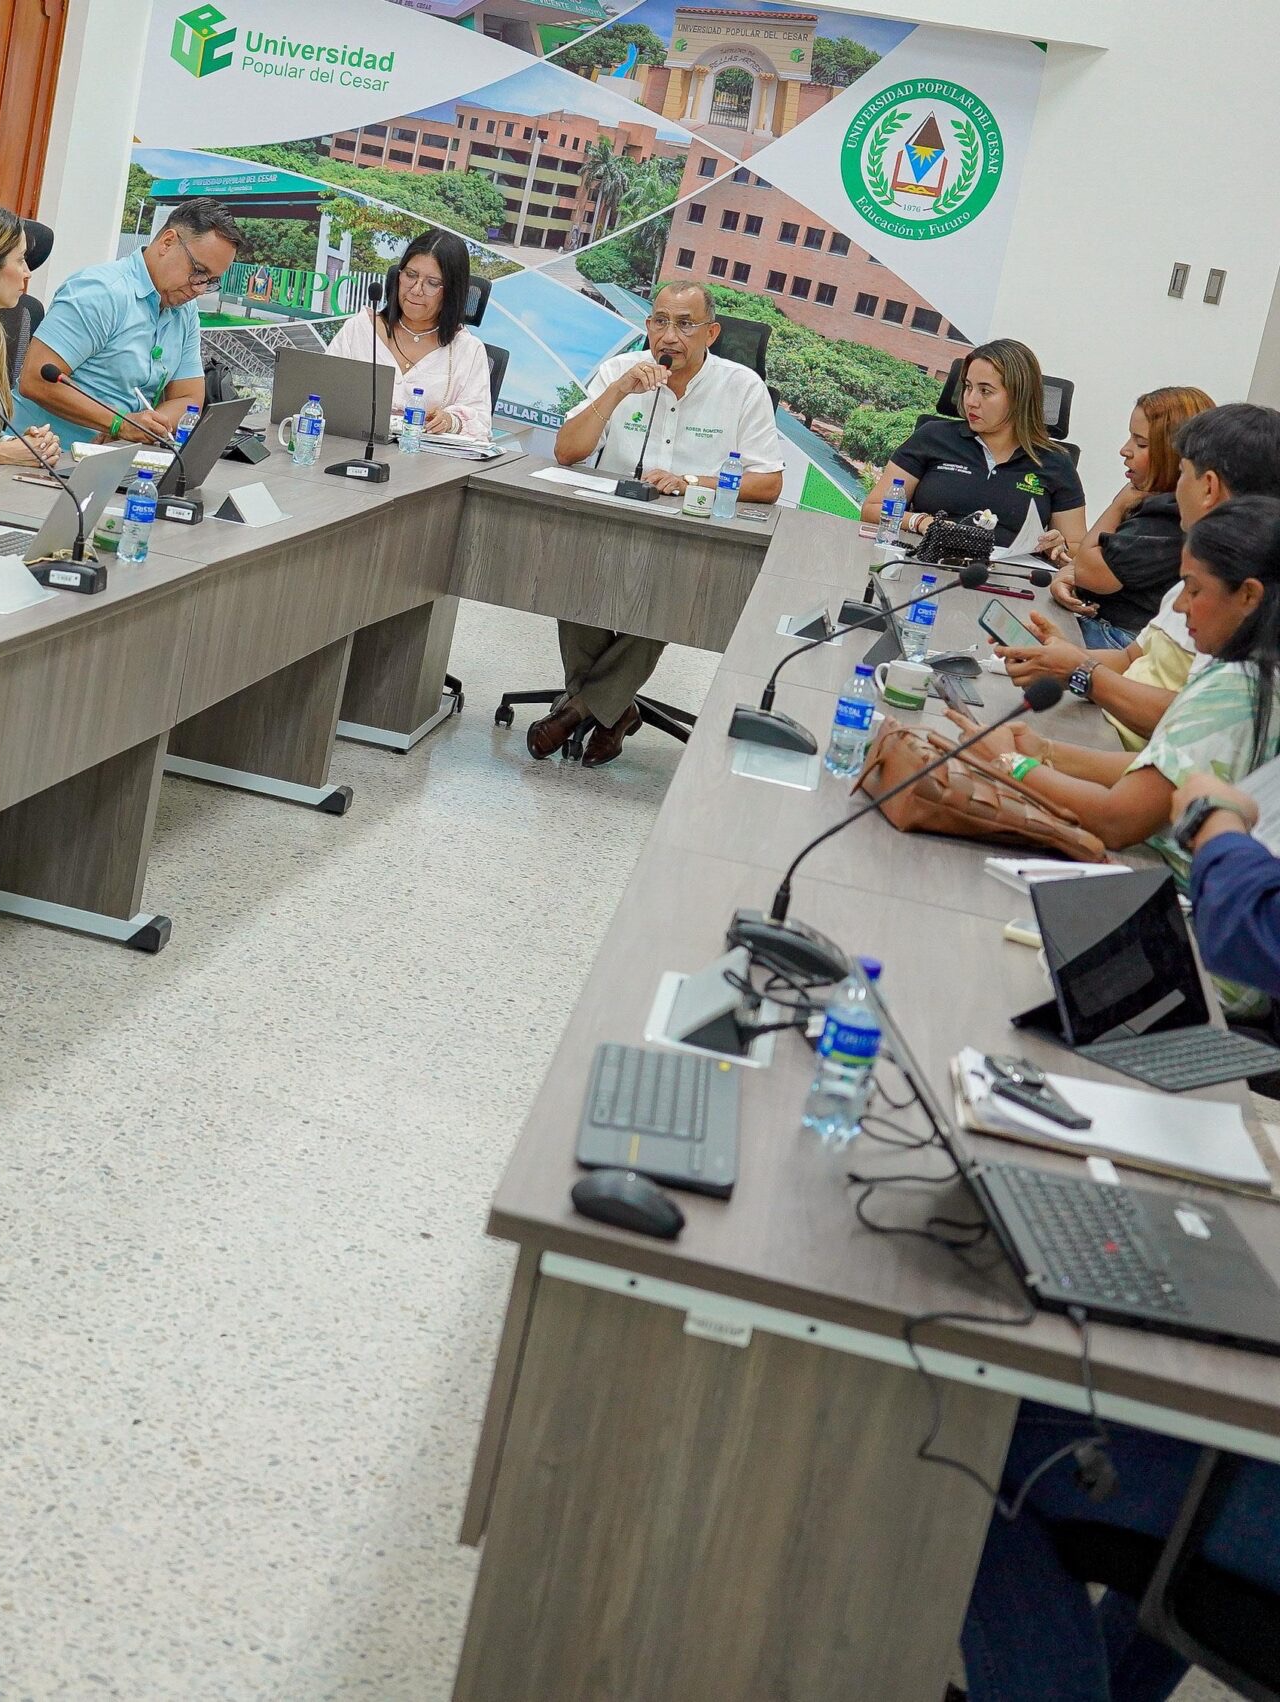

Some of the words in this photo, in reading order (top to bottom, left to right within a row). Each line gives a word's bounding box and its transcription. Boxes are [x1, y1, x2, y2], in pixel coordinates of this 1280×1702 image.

[245, 30, 395, 73] Universidad
[677, 24, 722, 35] UNIVERSIDAD
[725, 28, 761, 38] POPULAR
[763, 30, 779, 40] DEL
[782, 31, 809, 42] CESAR
[242, 56, 306, 80] Popular
[309, 67, 334, 84] del
[339, 70, 390, 92] Cesar
[847, 84, 914, 149] UNIVERSIDAD
[917, 82, 974, 110] POPULAR
[971, 105, 993, 132] DEL
[985, 131, 1000, 175] CESAR
[856, 195, 915, 237] Educación
[917, 226, 926, 240] y
[928, 210, 971, 237] Futuro
[901, 203, 922, 213] 1976
[279, 268, 359, 317] UPC
